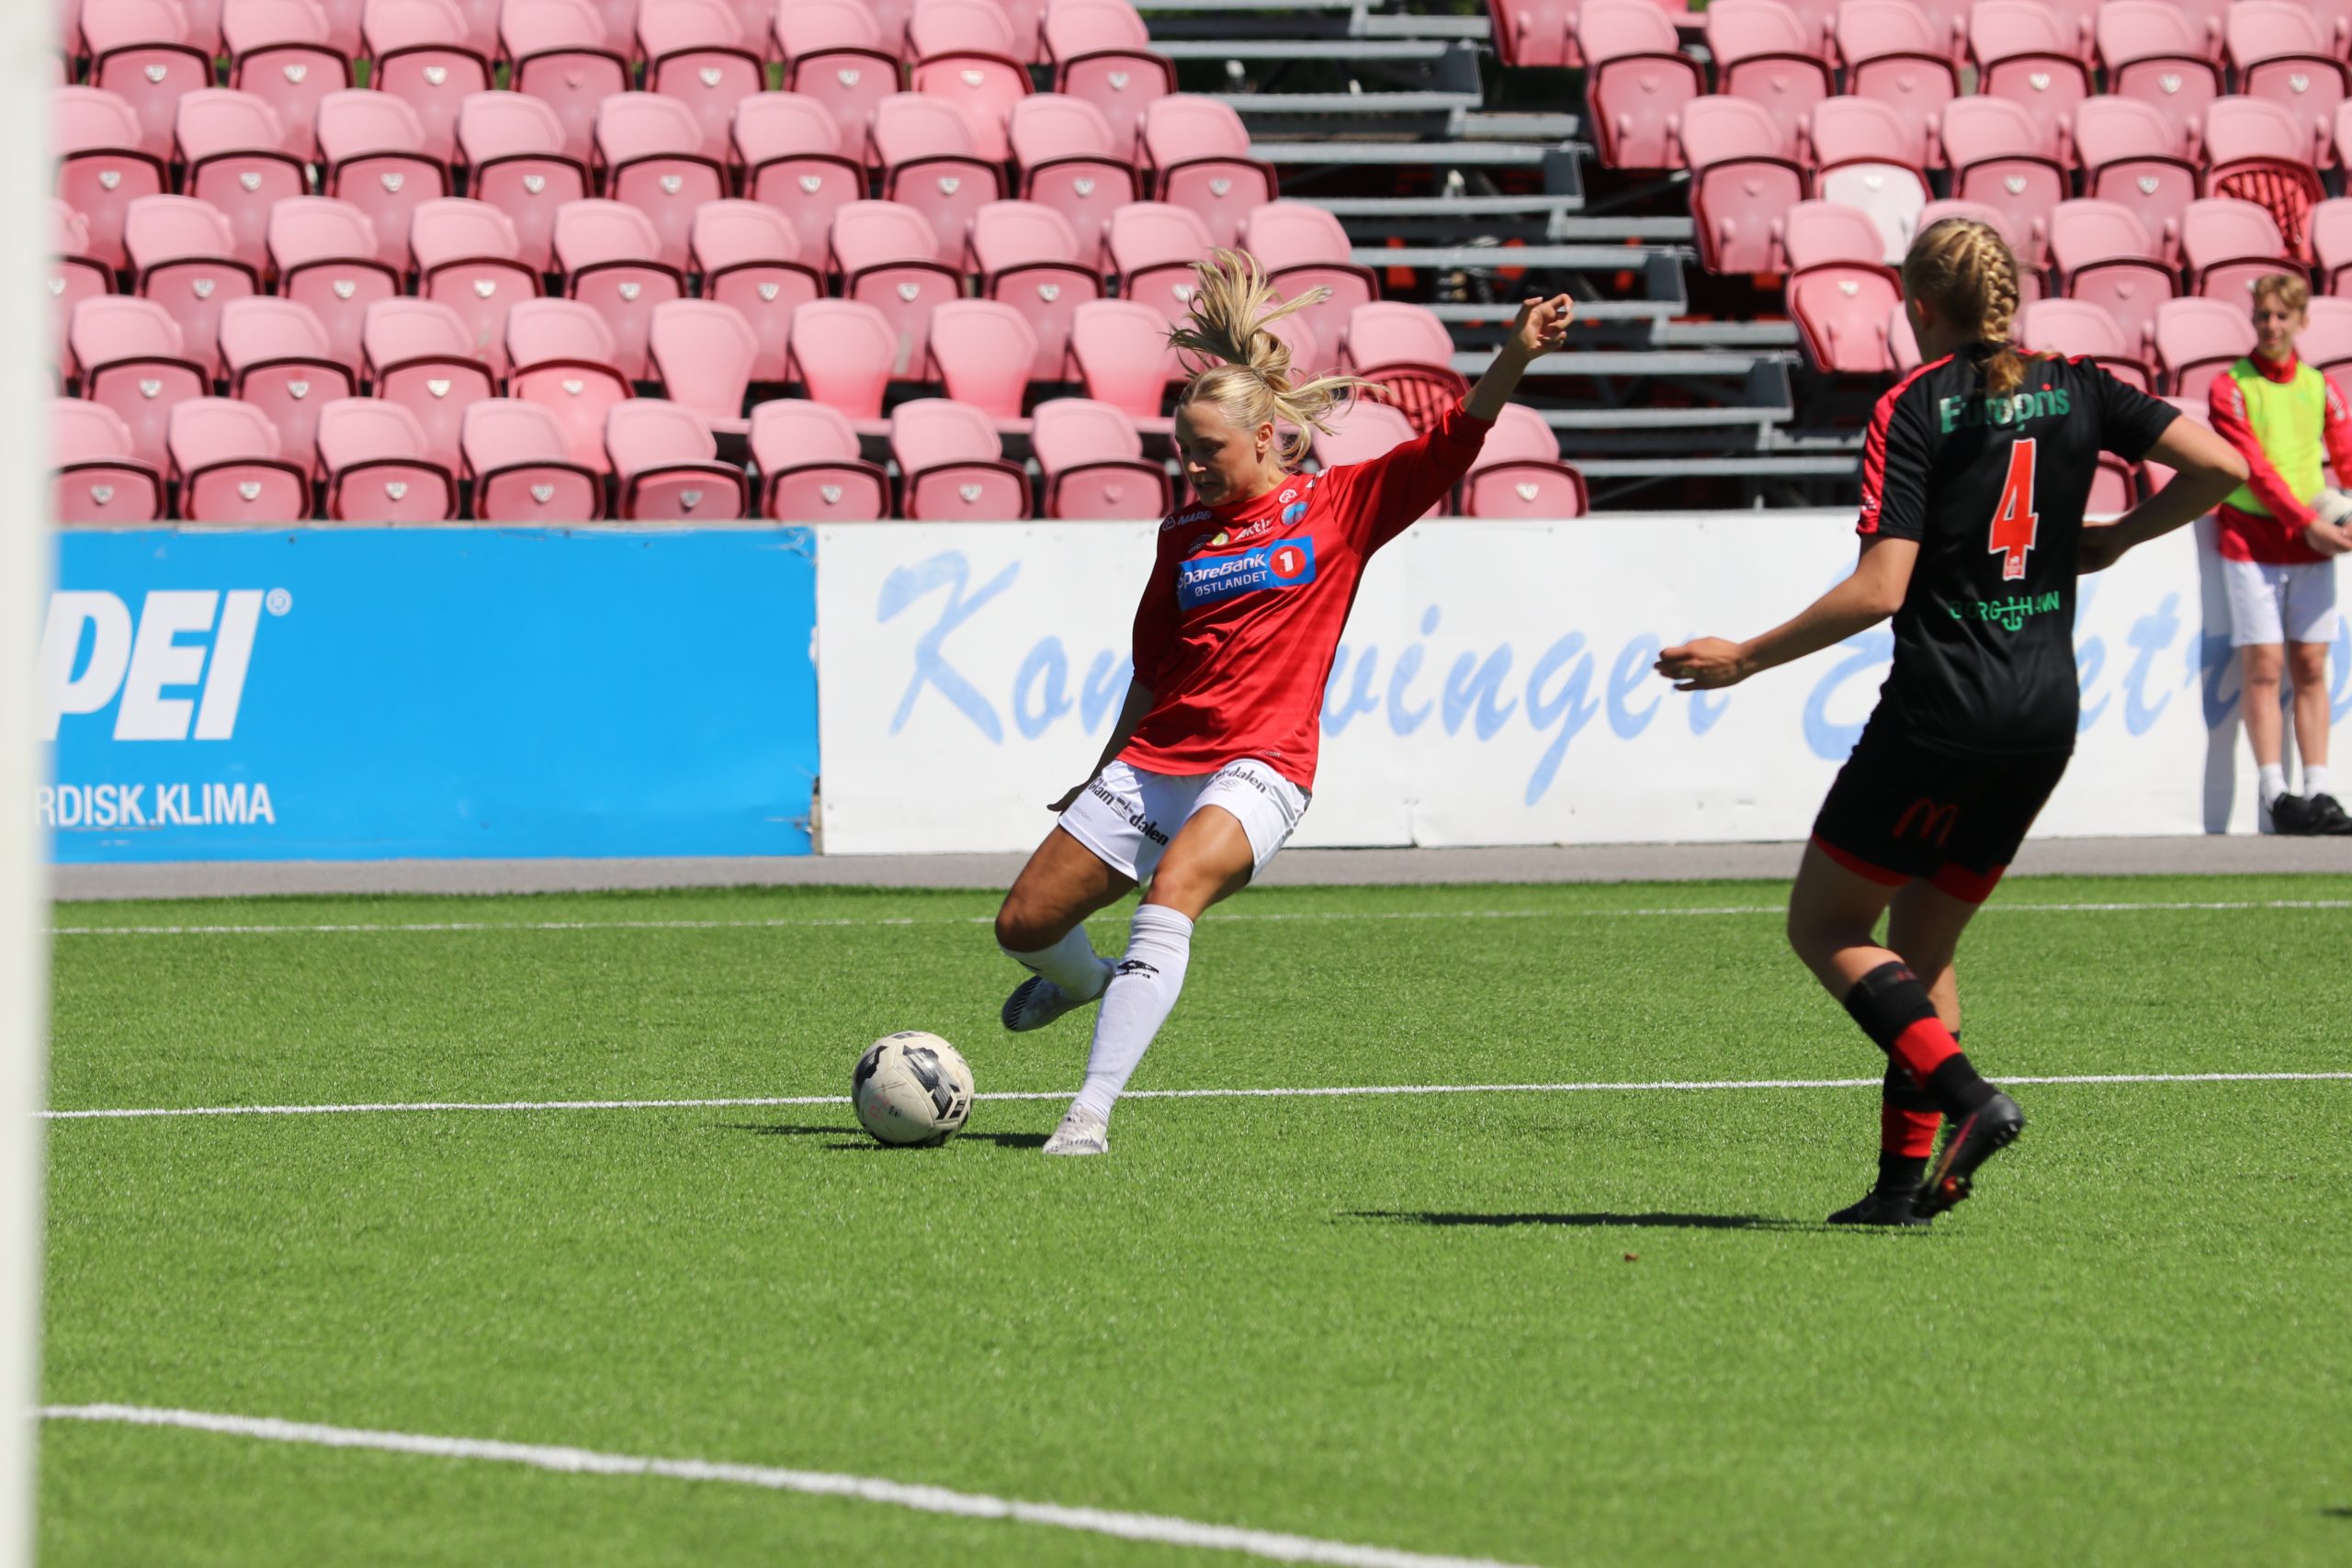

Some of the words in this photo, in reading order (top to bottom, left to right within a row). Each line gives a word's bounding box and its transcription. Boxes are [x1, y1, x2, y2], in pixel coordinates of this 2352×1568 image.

[1989, 437, 2039, 581] 4
[1177, 553, 1266, 589] SpareBank
[1279, 551, 1294, 572] 1
[1195, 570, 1268, 597] ØSTLANDET
